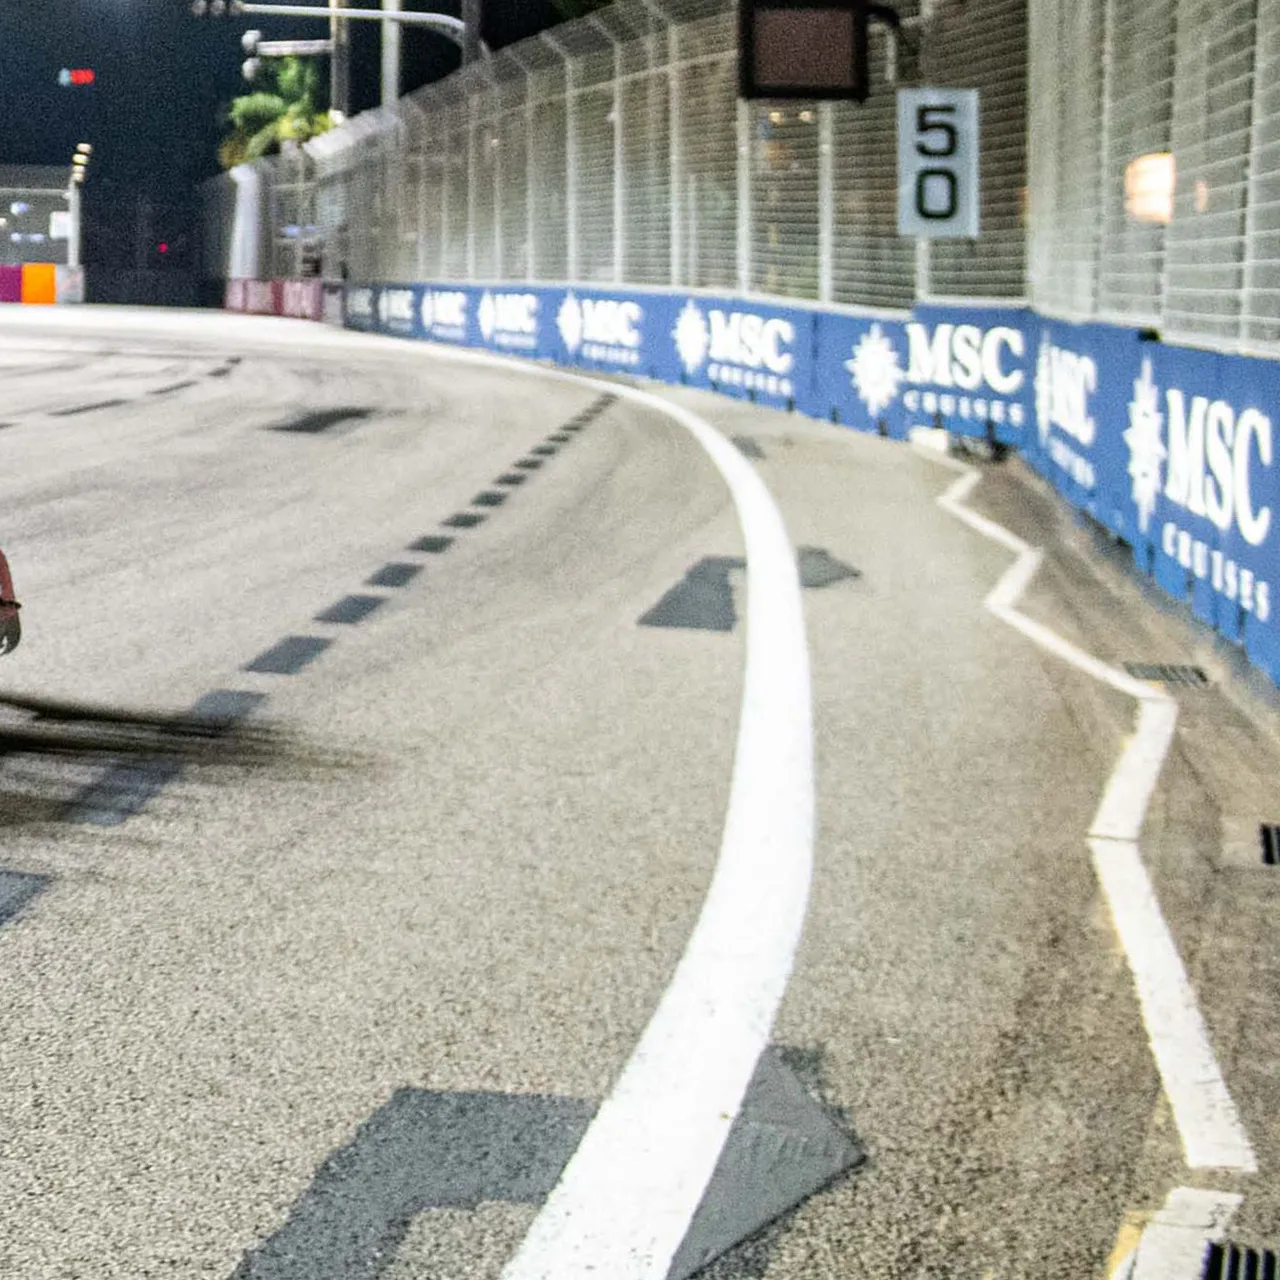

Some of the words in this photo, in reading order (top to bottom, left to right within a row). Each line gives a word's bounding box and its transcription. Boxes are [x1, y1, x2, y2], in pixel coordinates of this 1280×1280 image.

[708, 309, 796, 374] MSC
[904, 324, 1025, 394] MSC
[903, 390, 1025, 427] CRUISES
[1165, 389, 1272, 547] MSC
[1162, 523, 1270, 622] CRUISES
